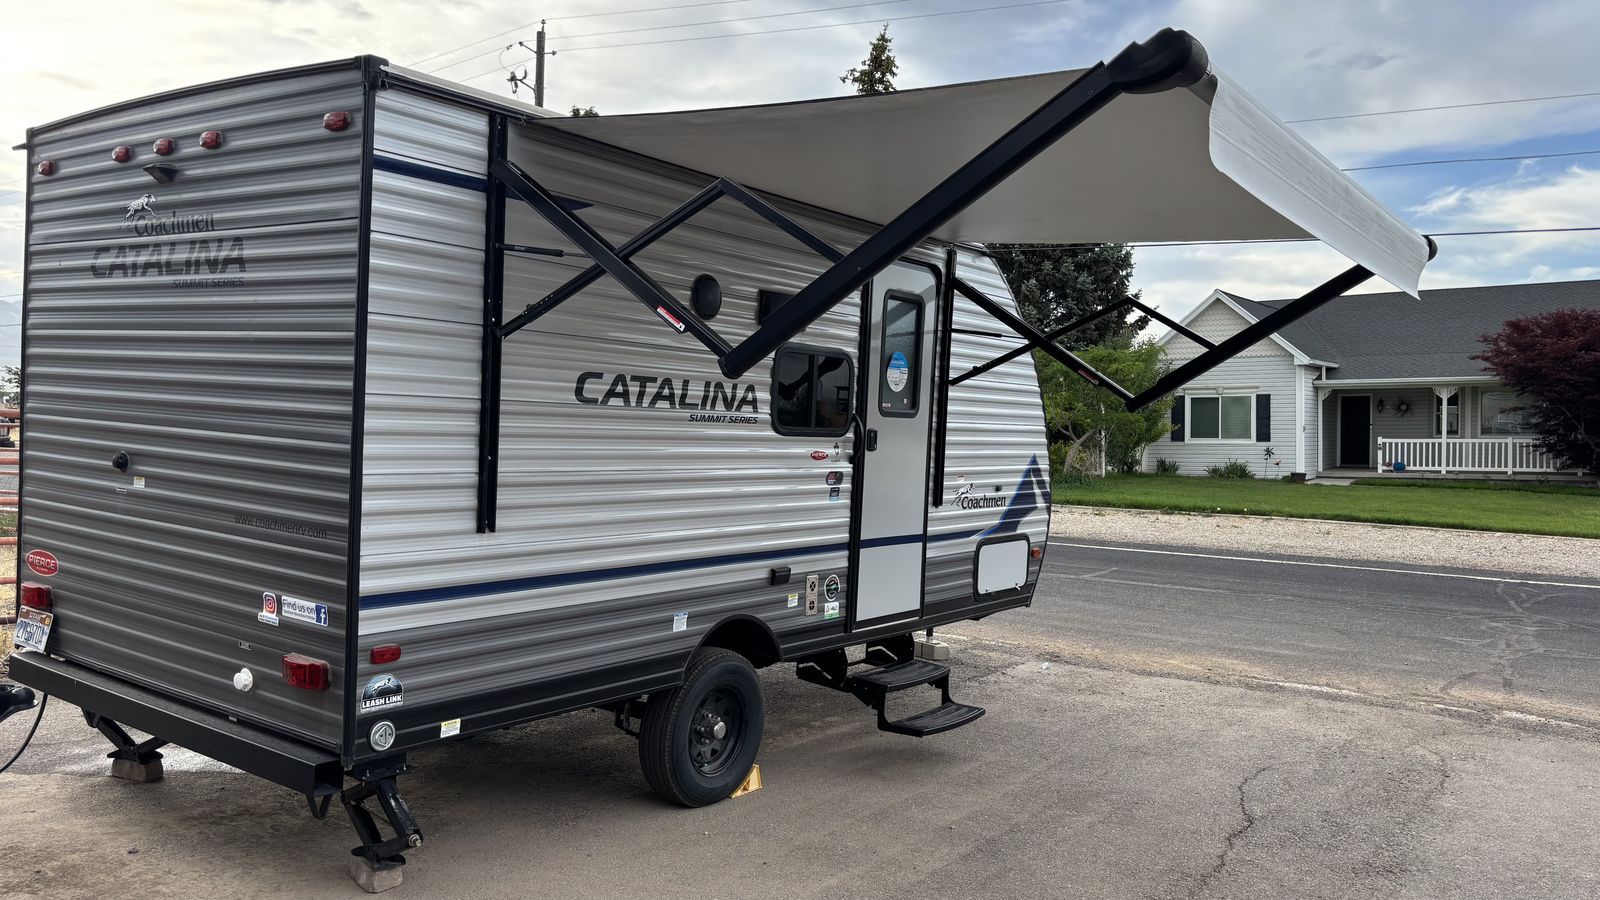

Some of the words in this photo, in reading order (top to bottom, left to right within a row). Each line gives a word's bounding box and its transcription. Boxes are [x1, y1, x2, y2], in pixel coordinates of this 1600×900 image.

[134, 211, 216, 237] Coachmen
[90, 237, 247, 278] CATALINA
[173, 278, 210, 289] SUMMIT
[210, 276, 245, 287] SERIES
[574, 371, 759, 413] CATALINA
[688, 414, 728, 424] SUMMIT
[727, 415, 759, 425] SERIES
[961, 494, 1007, 510] Coachmen
[232, 511, 328, 540] www.coachmenrv.com
[28, 554, 56, 570] PIERCE
[282, 598, 297, 611] Find
[297, 605, 306, 613] us
[306, 607, 316, 616] on
[362, 697, 385, 708] LEASH
[385, 694, 402, 704] LINK
